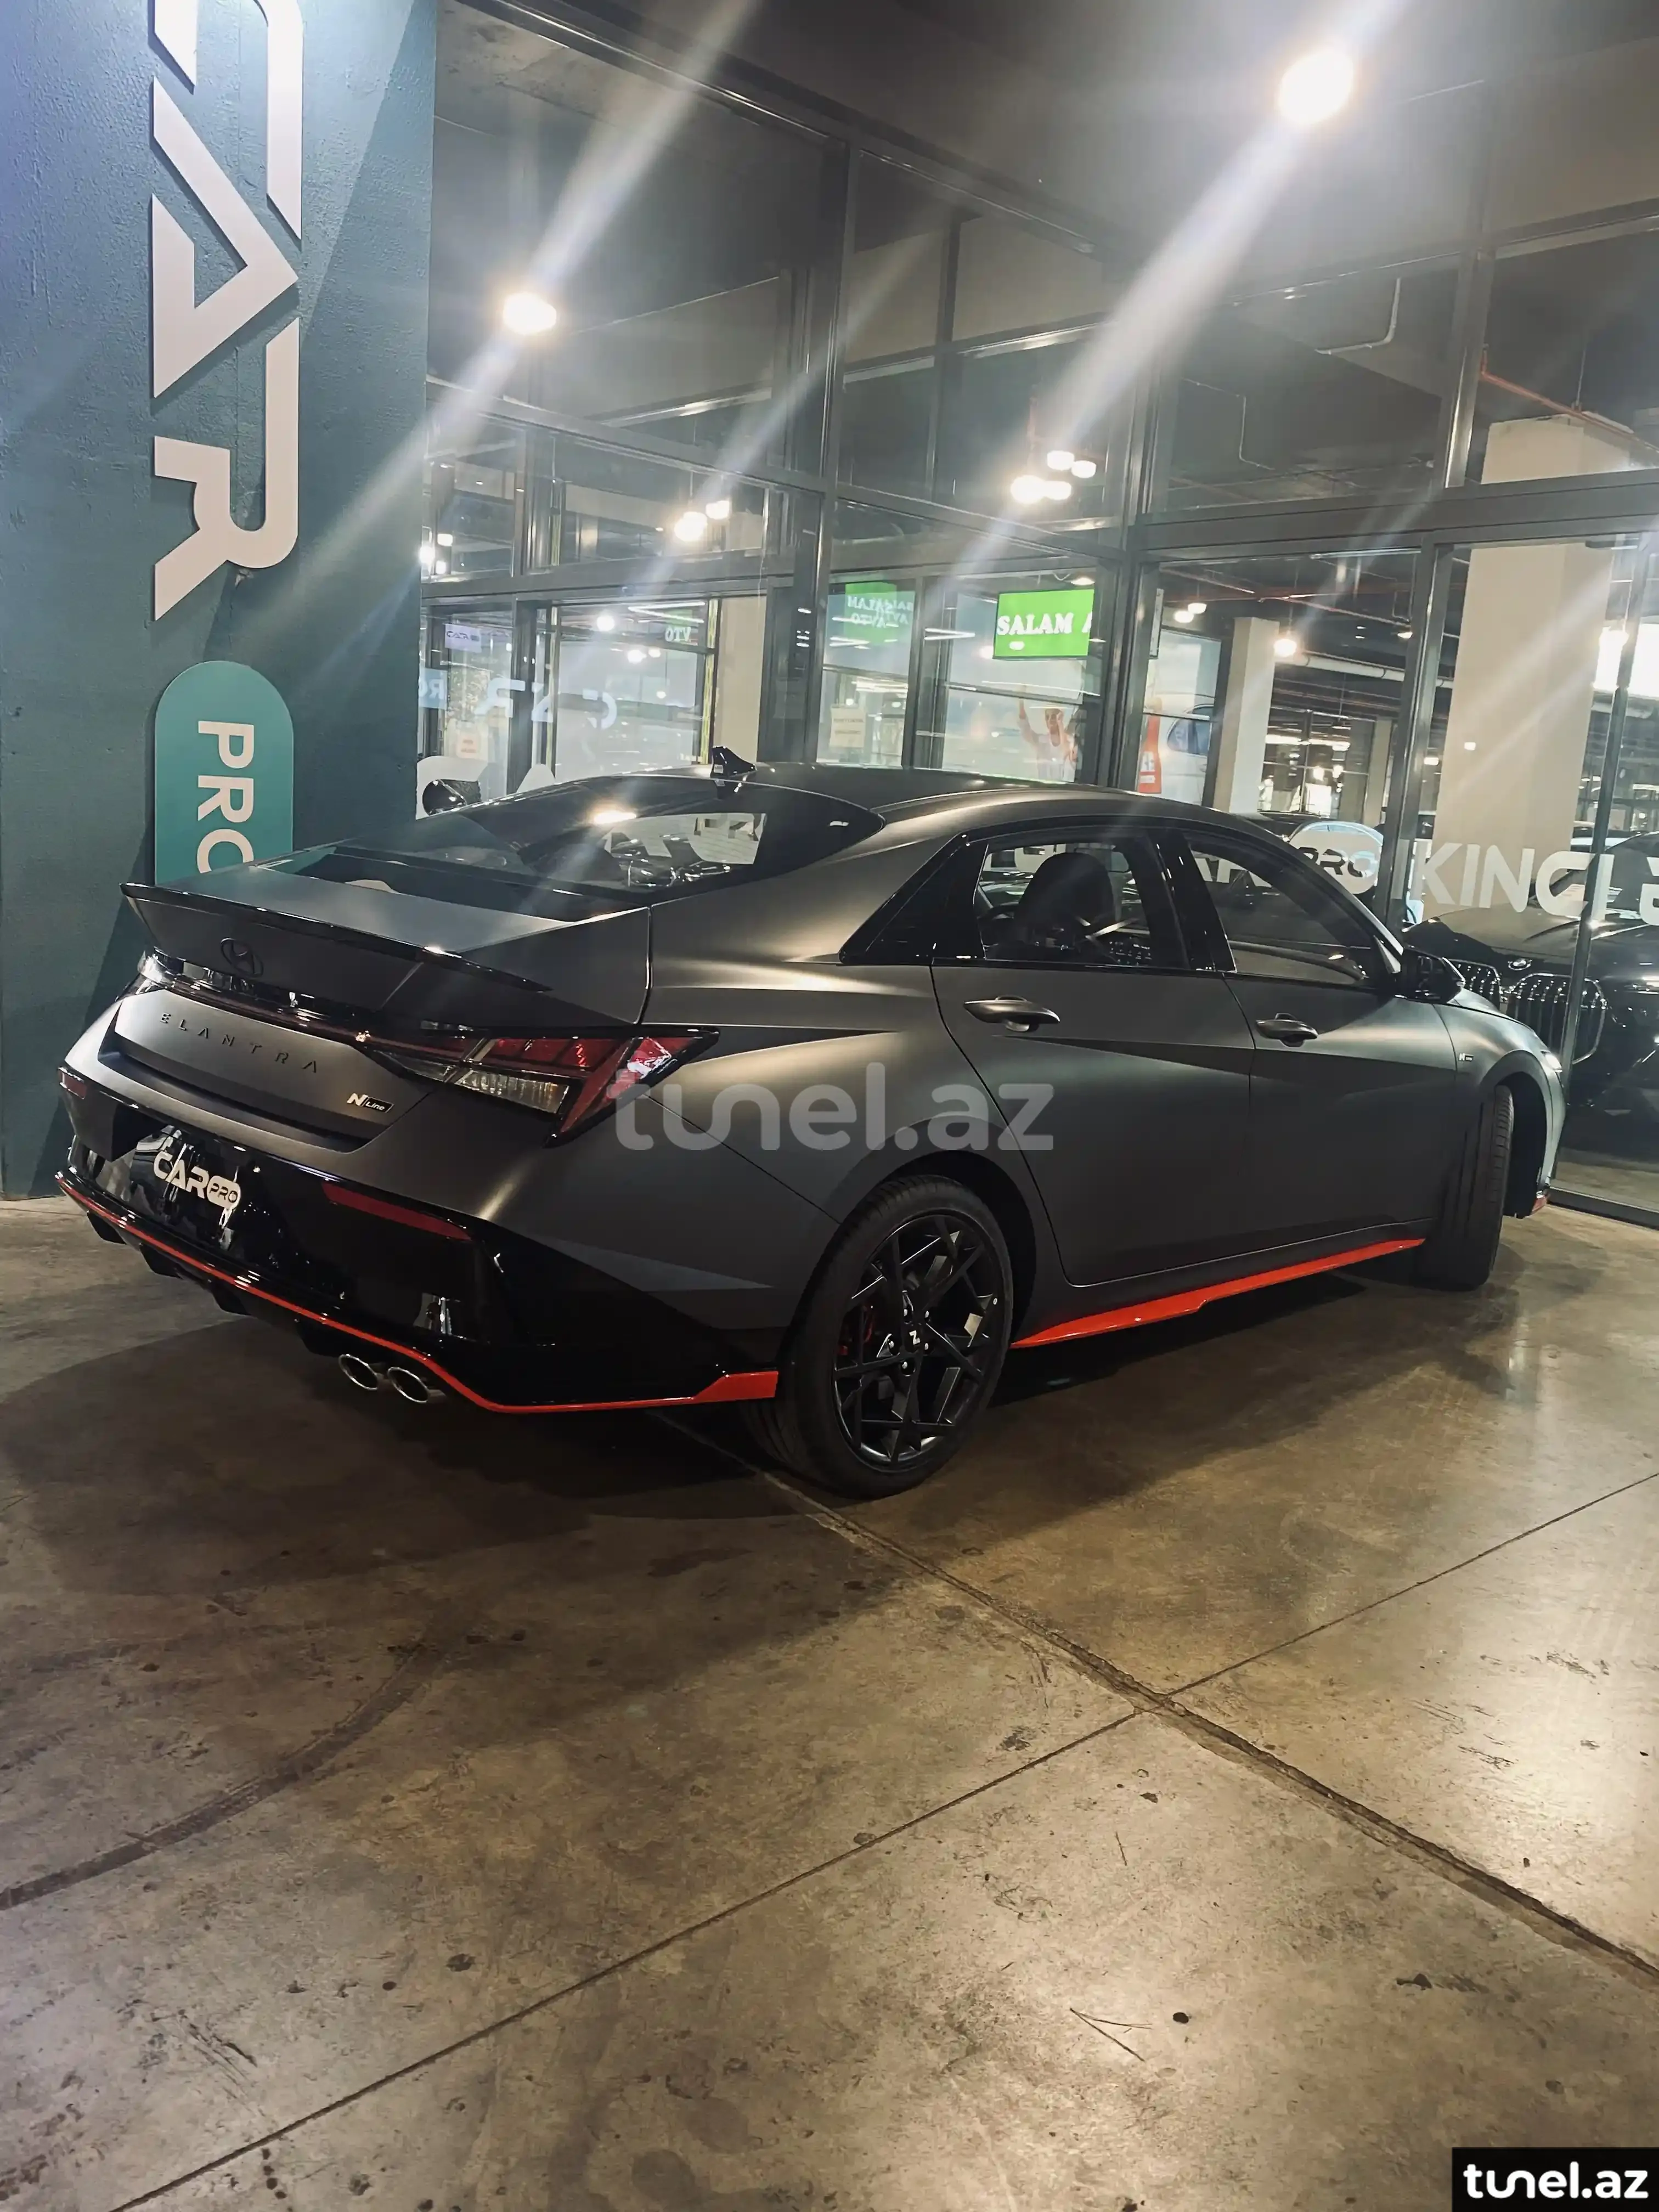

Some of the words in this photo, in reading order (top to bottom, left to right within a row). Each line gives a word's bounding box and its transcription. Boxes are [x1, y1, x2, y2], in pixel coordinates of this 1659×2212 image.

[996, 612, 1074, 635] SALAM
[160, 1013, 317, 1073] ELANTRA
[346, 1093, 369, 1106] N
[365, 1101, 385, 1110] Line
[154, 1151, 210, 1199] CAR
[209, 1182, 238, 1203] PRO
